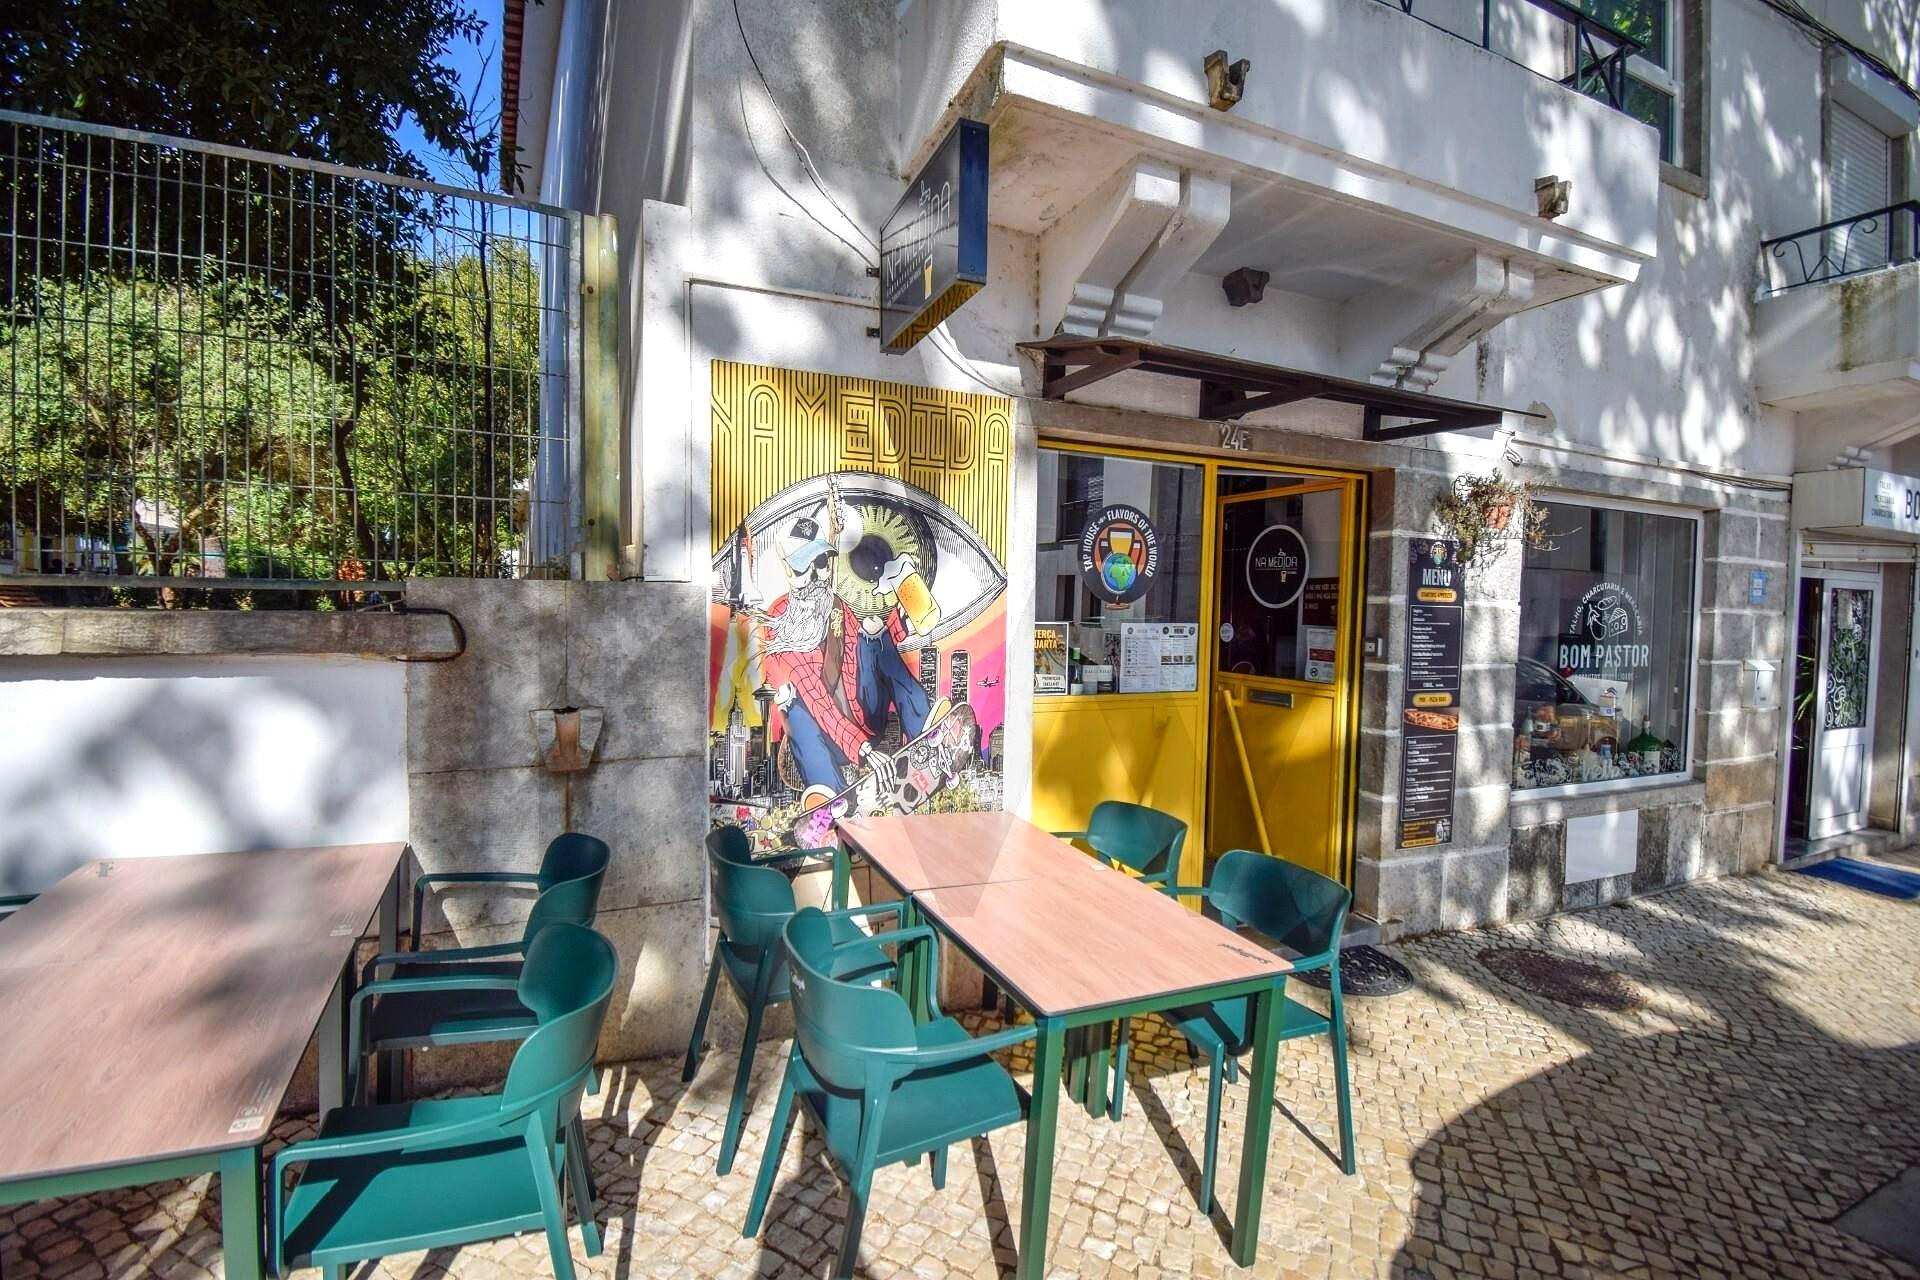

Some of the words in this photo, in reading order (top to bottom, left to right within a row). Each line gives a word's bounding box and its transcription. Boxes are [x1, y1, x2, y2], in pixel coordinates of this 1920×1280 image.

[1106, 508, 1140, 524] FLAVORS
[1137, 519, 1150, 531] OF
[1082, 521, 1100, 552] HOUSE
[1144, 528, 1157, 547] THE
[1082, 554, 1093, 572] TAP
[1144, 546, 1158, 577] WORLD
[1255, 556, 1267, 568] NA
[1268, 554, 1298, 570] MEDIDA
[1422, 568, 1452, 587] MENU
[1034, 638, 1058, 649] UARTA
[1559, 644, 1591, 669] BOM
[1595, 644, 1649, 668] PASTOR
